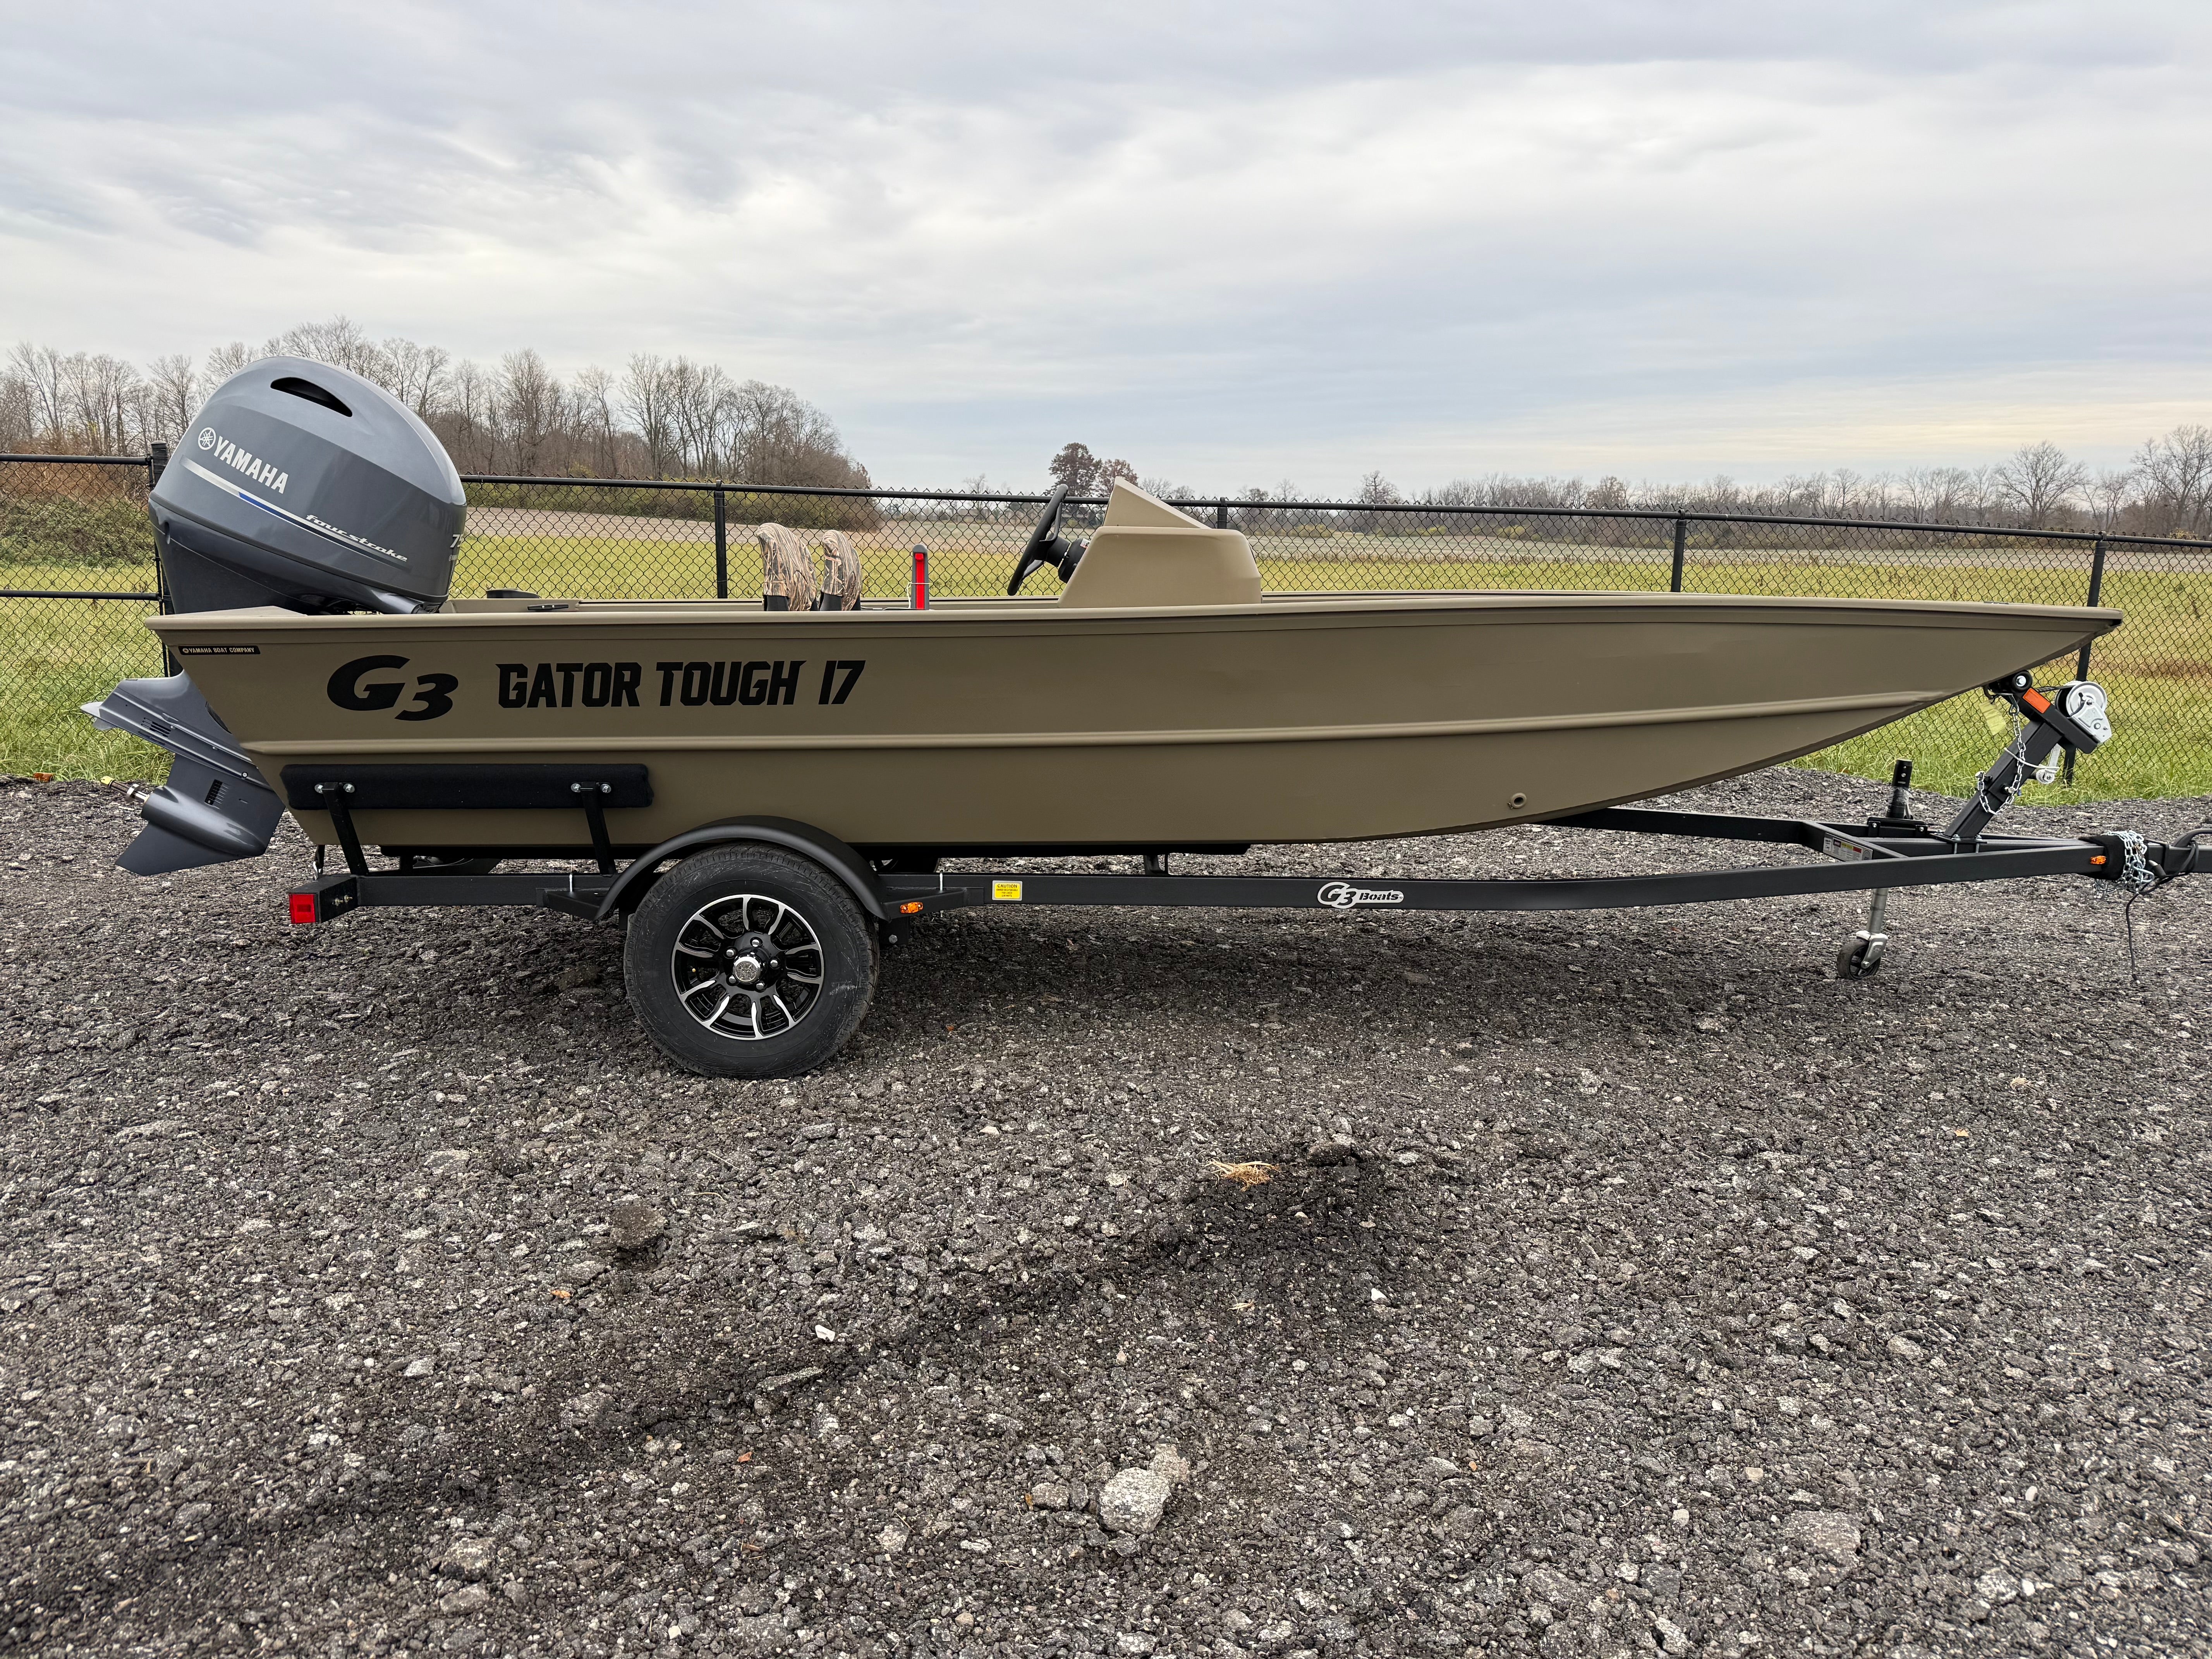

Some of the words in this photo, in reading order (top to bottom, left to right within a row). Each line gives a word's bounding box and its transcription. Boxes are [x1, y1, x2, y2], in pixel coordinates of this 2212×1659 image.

[214, 435, 289, 494] YAMAHA
[327, 654, 459, 721] G3
[495, 662, 642, 708] GATOR
[656, 660, 807, 706] TOUGH
[818, 660, 866, 705] 17
[1319, 884, 1357, 906] G3
[1359, 891, 1399, 900] Boats
